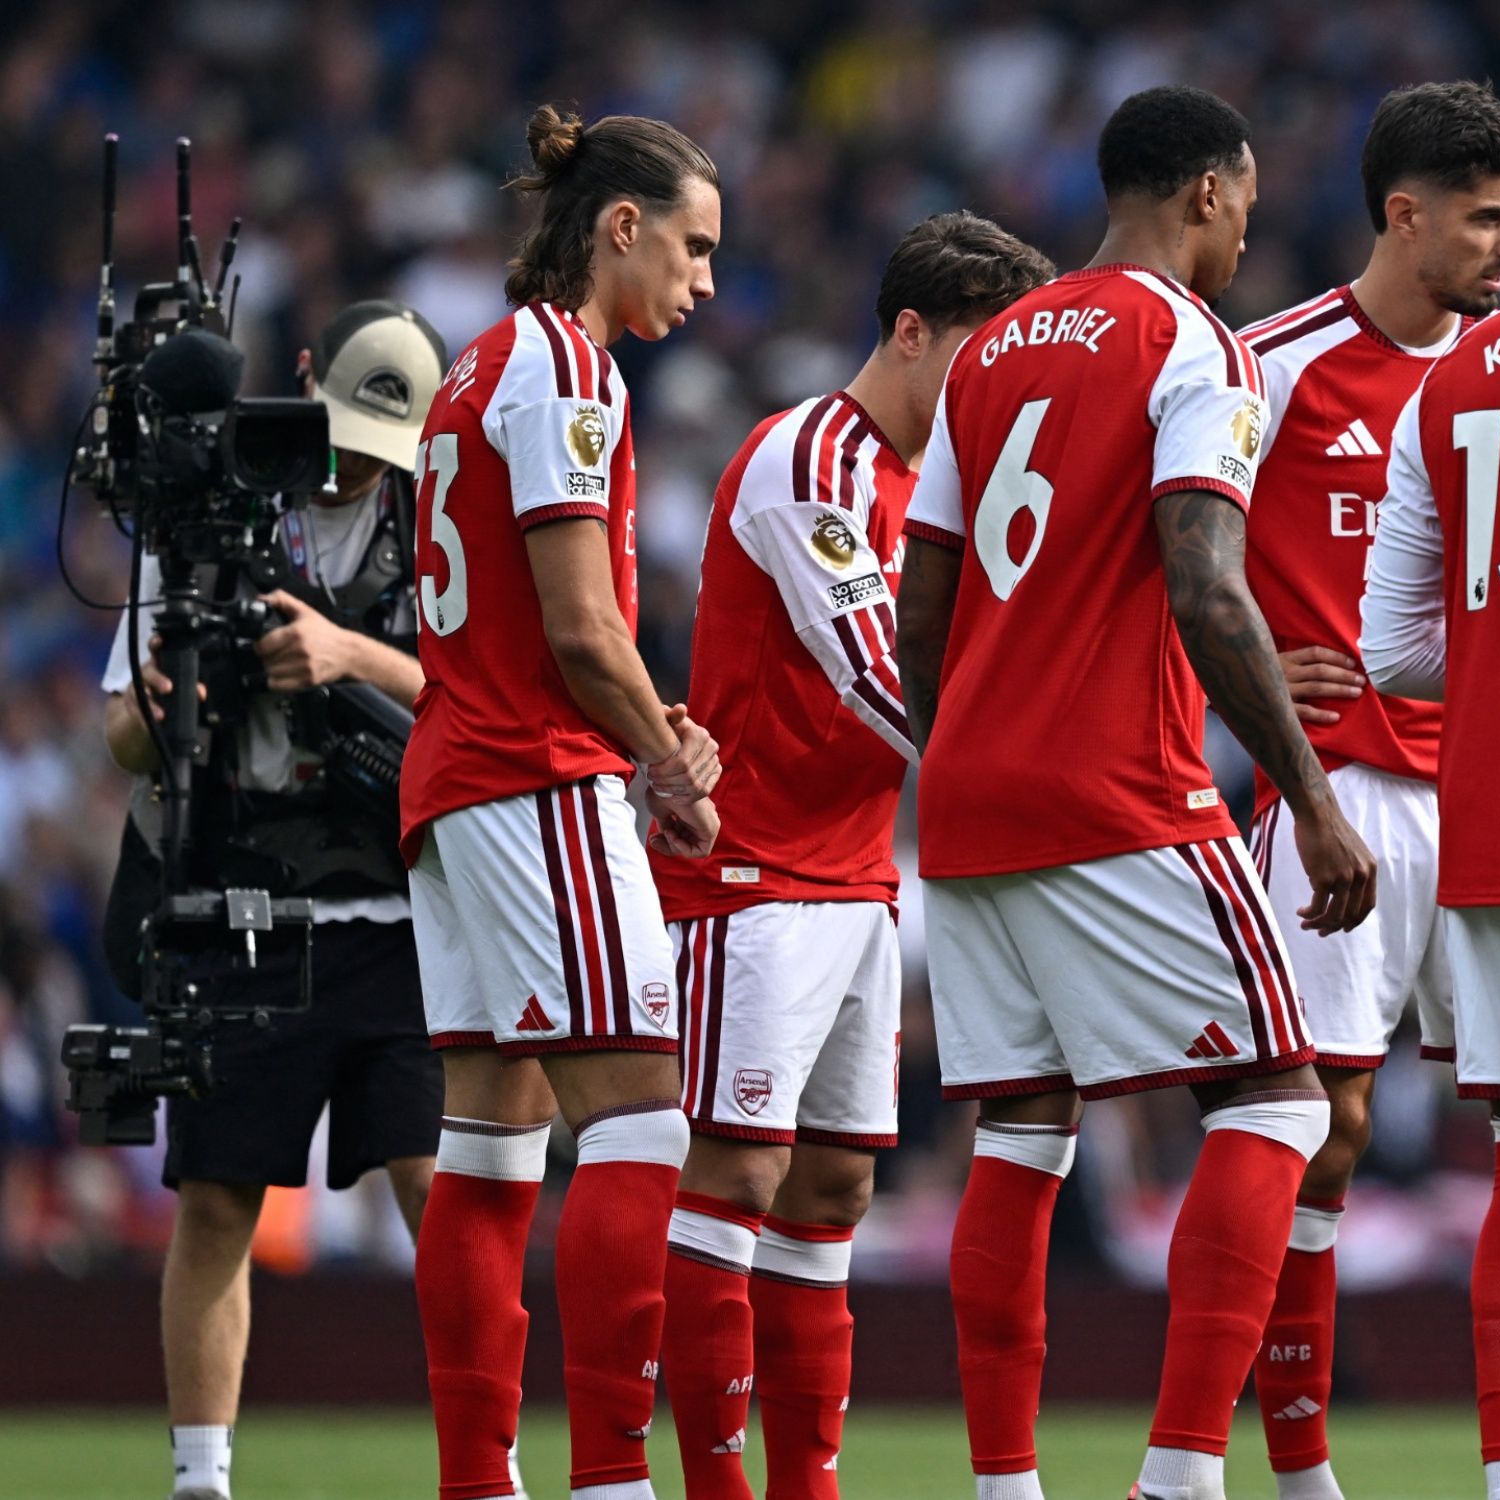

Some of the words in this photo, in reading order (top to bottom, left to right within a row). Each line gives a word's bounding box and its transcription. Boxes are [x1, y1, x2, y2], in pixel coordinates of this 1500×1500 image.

[980, 306, 1117, 368] GABRIEL
[566, 473, 584, 486] No
[974, 397, 1054, 601] 6
[829, 586, 848, 598] No
[849, 577, 878, 592] room
[740, 1076, 768, 1086] Arsenal
[1269, 1344, 1311, 1361] AFC
